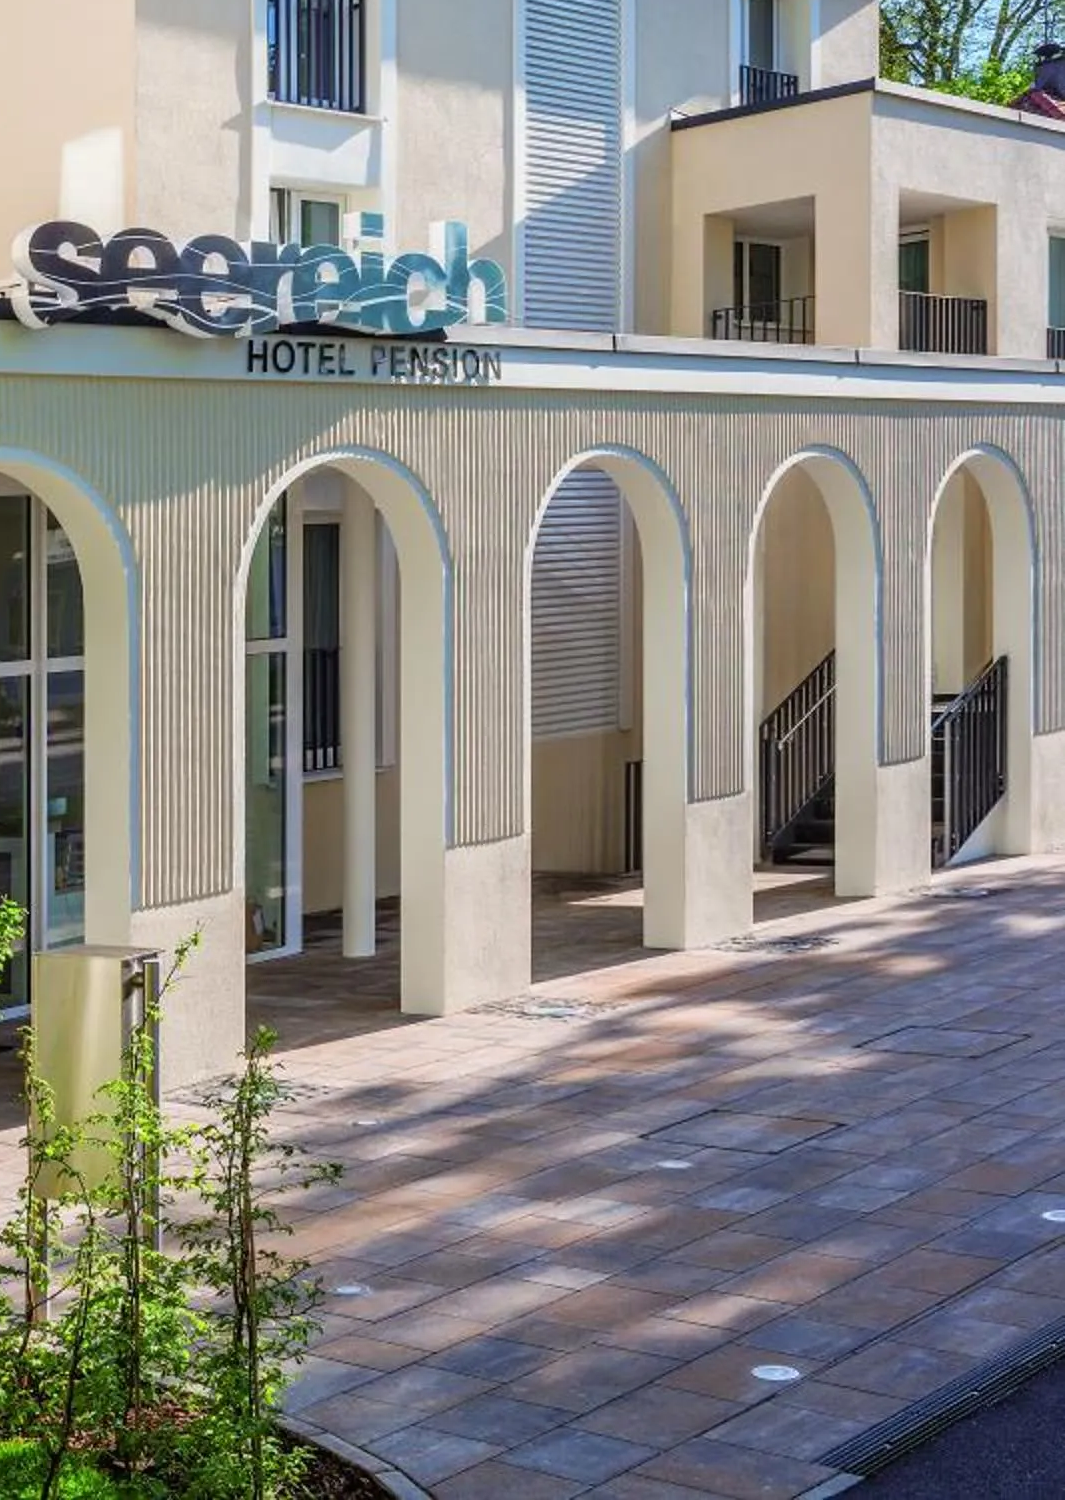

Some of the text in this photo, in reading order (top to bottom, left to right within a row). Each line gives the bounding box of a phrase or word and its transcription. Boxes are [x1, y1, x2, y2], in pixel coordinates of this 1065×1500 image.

[14, 211, 508, 337] Seereich
[247, 339, 502, 381] HOTEL PENSION
